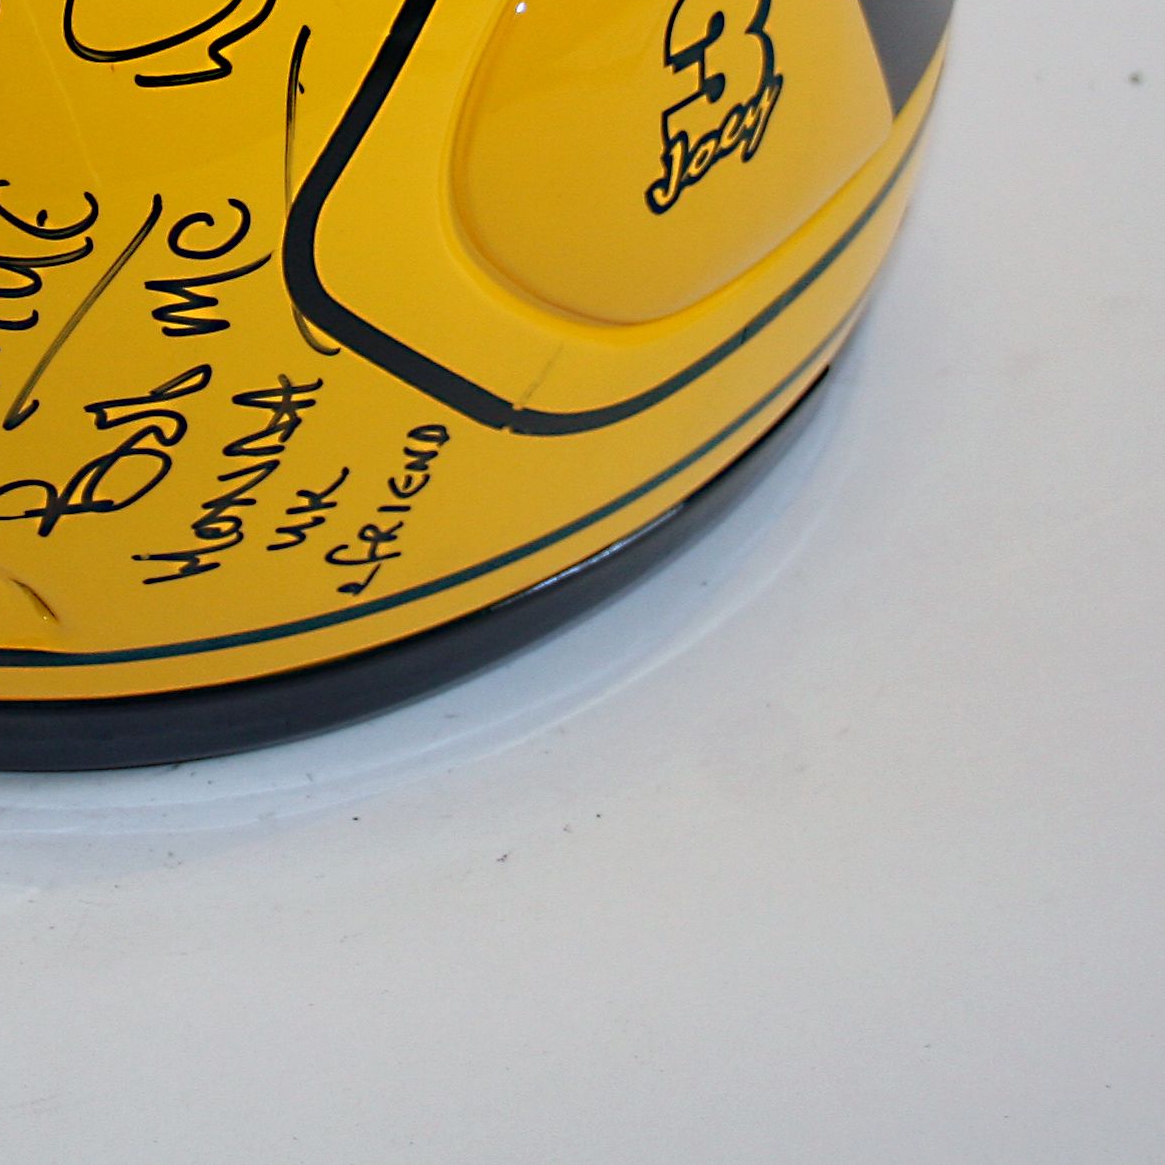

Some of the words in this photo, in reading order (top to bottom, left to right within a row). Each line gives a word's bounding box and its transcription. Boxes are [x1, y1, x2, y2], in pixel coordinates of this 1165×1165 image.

[644, 73, 784, 215] Joey
[132, 373, 324, 586] HONDA
[267, 467, 350, 551] UK
